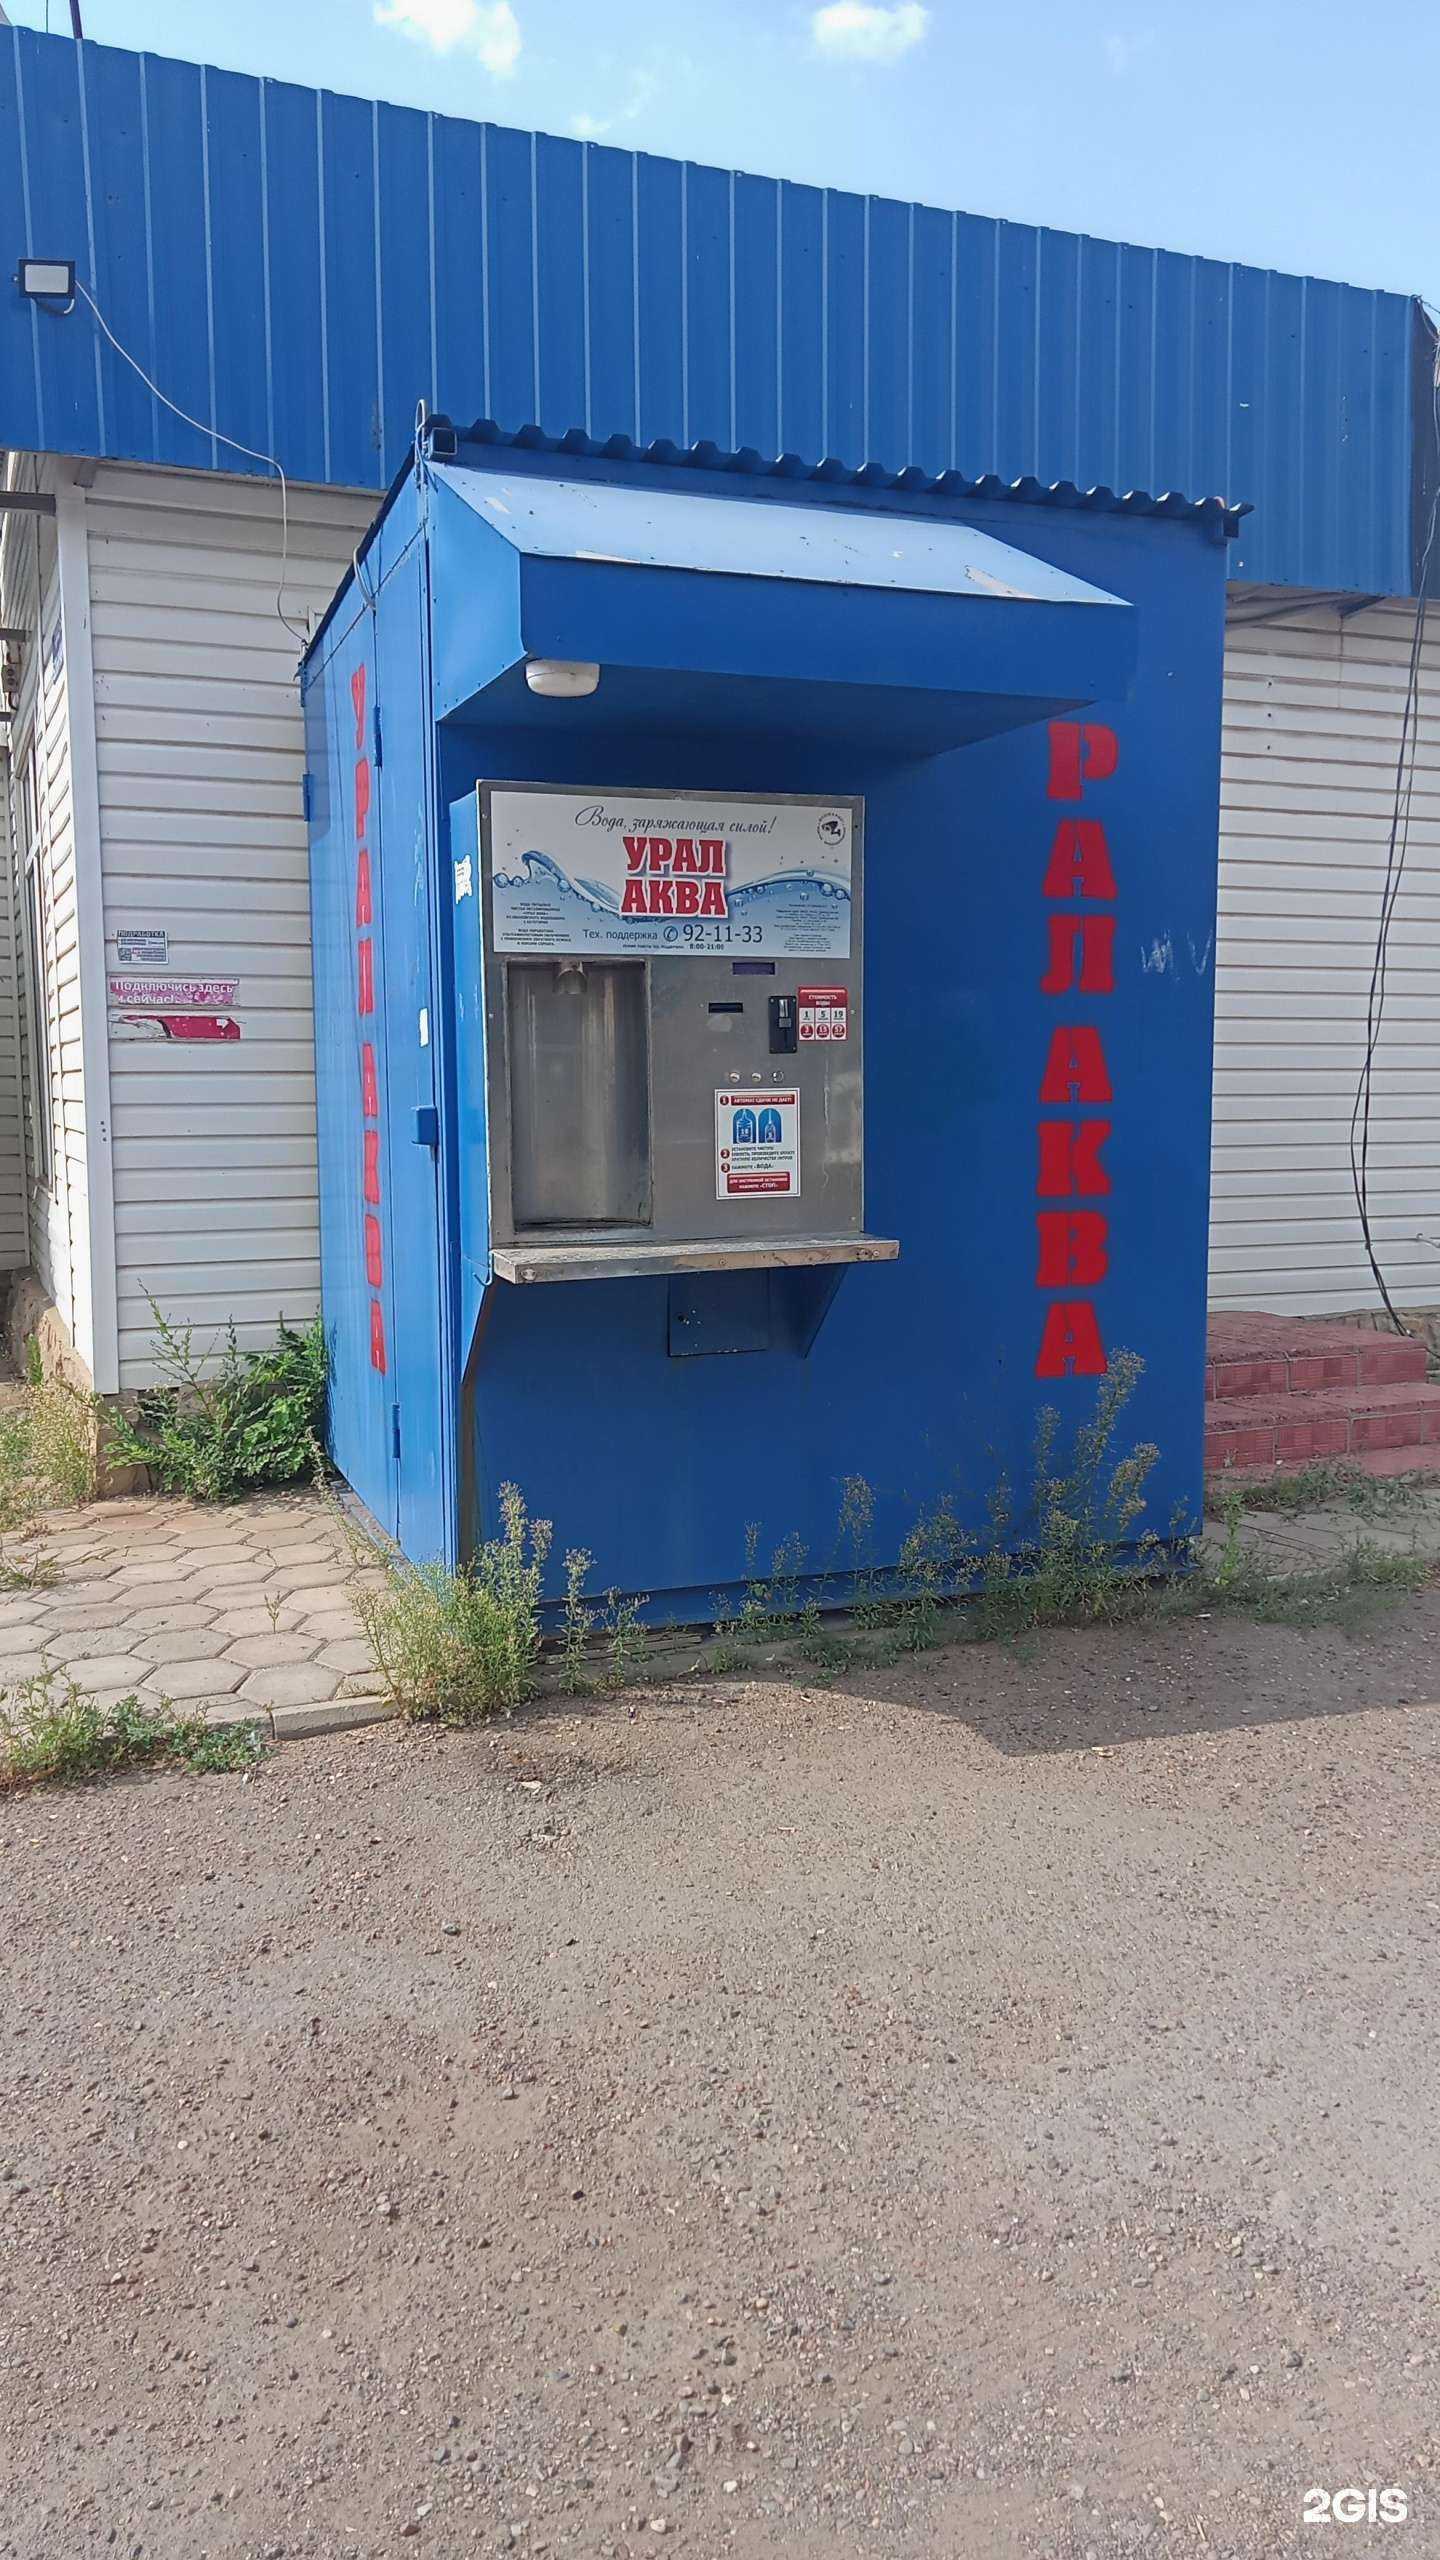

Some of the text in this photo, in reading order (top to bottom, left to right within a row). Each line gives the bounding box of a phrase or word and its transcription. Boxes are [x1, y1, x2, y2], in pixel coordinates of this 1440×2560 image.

[575, 805, 777, 834] Вода, заряжающая силой!
[622, 836, 726, 875] УРАЛ
[620, 878, 728, 917] АКВА
[583, 929, 603, 939] Тех.
[606, 930, 658, 942] поддержка
[683, 924, 763, 943] 92-11-33
[115, 981, 234, 994] Подключись здесь
[127, 994, 174, 1004] сейчас!
[351, 662, 387, 1376] УРАЛ АКВА
[1034, 721, 1119, 1380] РАЛ АКВА
